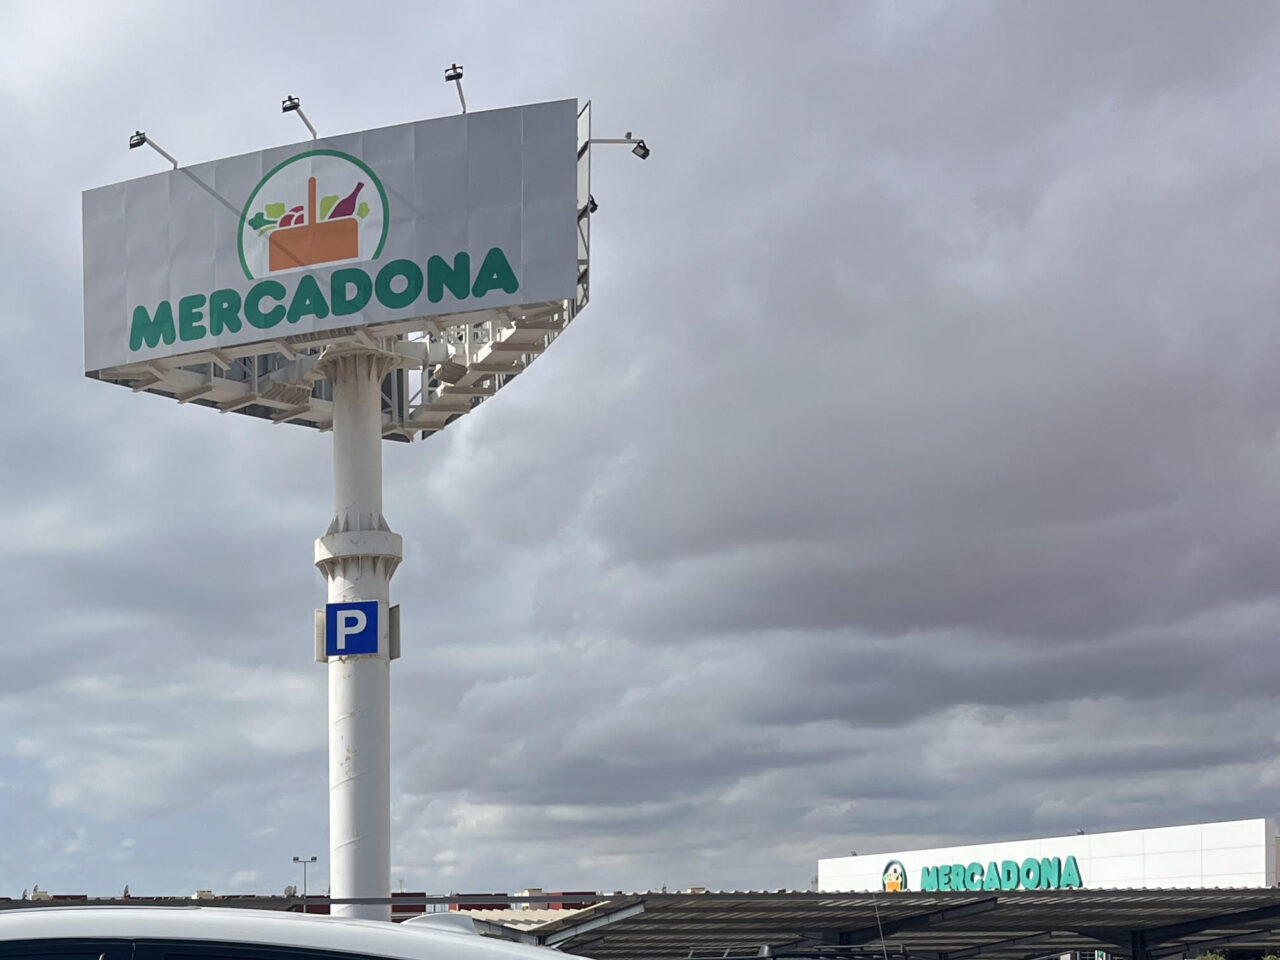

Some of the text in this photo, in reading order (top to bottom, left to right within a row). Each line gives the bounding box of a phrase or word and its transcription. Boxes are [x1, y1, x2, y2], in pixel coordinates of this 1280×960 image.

[129, 247, 519, 351] MERCADONA
[336, 609, 367, 650] P
[920, 855, 1083, 891] MERCADONA
